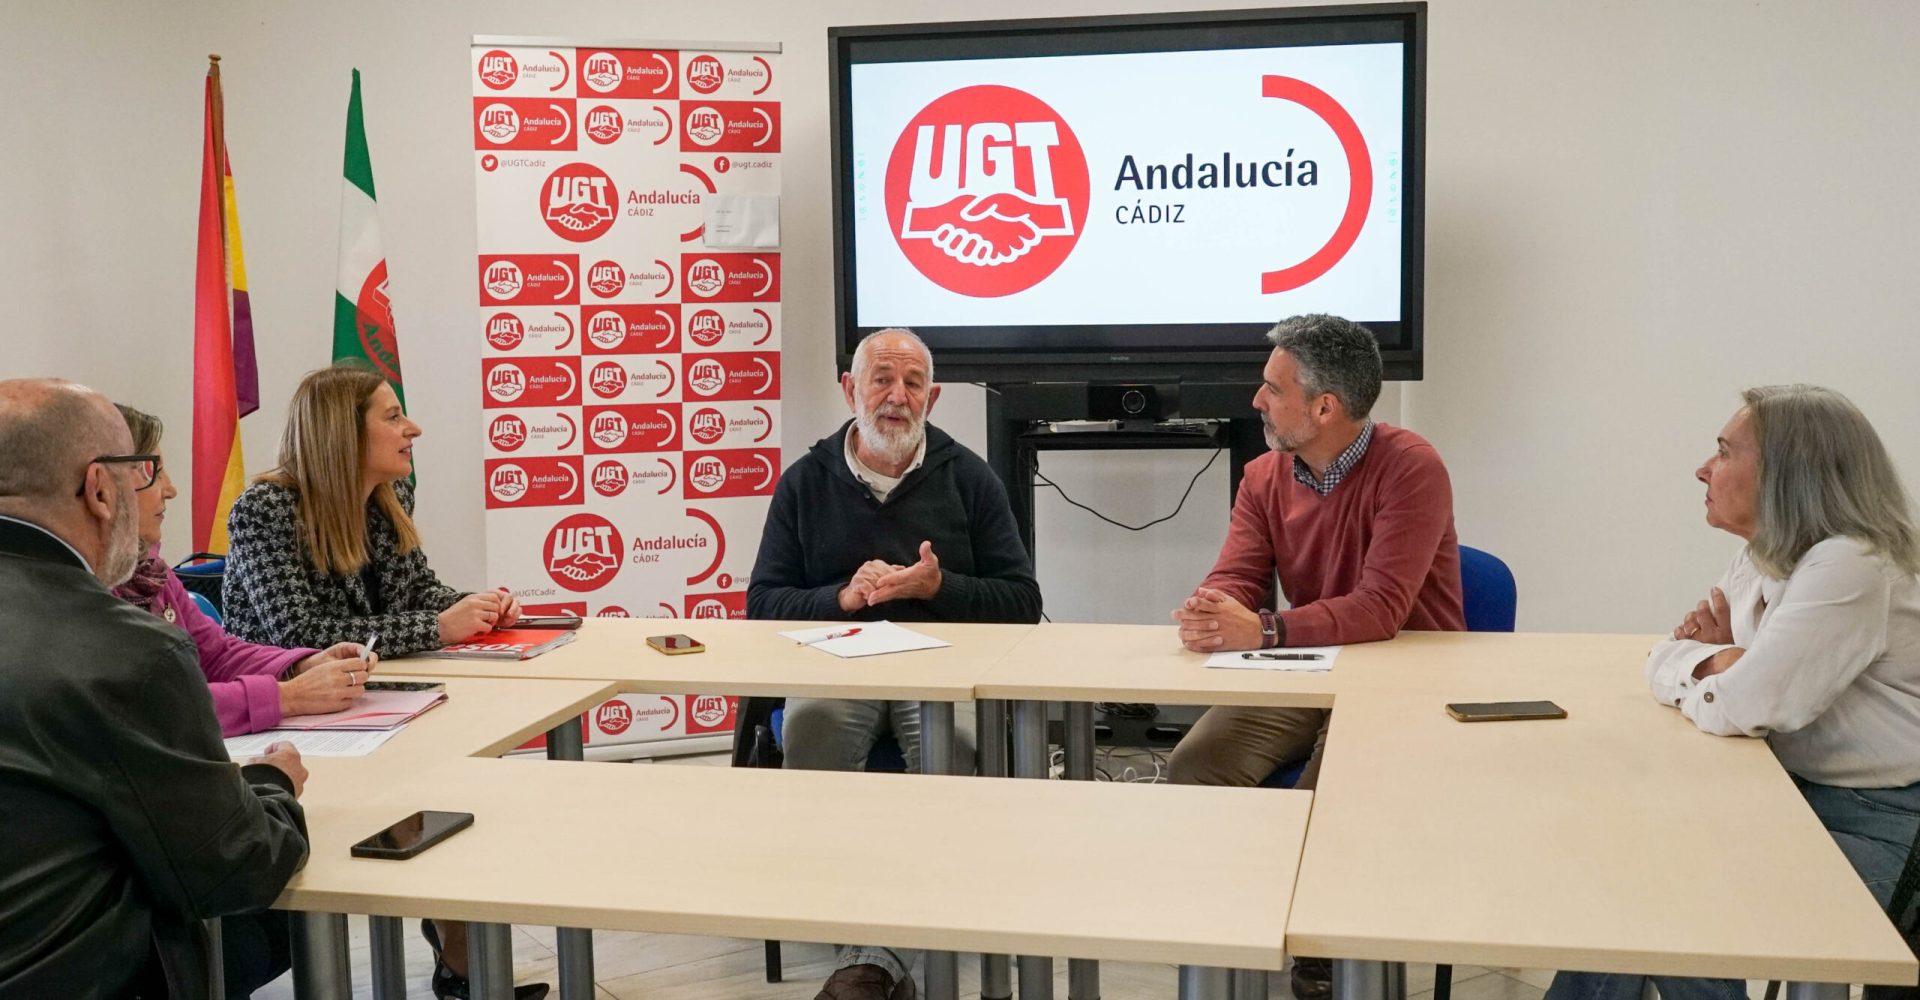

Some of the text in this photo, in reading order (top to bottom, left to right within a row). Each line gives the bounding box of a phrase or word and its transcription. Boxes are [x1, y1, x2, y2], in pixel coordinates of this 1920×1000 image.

[483, 57, 514, 73] UGT
[523, 64, 560, 73] Andalucía
[589, 59, 617, 75] UGT
[627, 67, 663, 75] Andalucía
[692, 61, 718, 76] UGT
[728, 68, 763, 76] Andalucía
[484, 111, 514, 126] UGT
[524, 118, 561, 126] Andalucía
[589, 112, 617, 126] UGT
[627, 119, 663, 127] Andalucía
[691, 114, 718, 128] UGT
[728, 120, 763, 129] Andalucía
[501, 158, 546, 168] @UGTCadiz
[732, 160, 772, 169] @ugt.cadiz
[910, 121, 1061, 205] UGT
[1114, 148, 1319, 191] Andalucía
[550, 177, 609, 206] UGT
[628, 189, 700, 205] Andalucía
[628, 207, 654, 216] CÁDIZ
[1116, 204, 1185, 225] CÁDIZ
[489, 268, 517, 283] UGT
[527, 273, 564, 281] Andalucía
[592, 267, 620, 282] UGT
[629, 272, 665, 280] Andalucía
[692, 266, 719, 280] UGT
[729, 271, 763, 279] Andalucía
[491, 319, 520, 334] UGT
[529, 324, 565, 332] Andalucía
[592, 318, 620, 332] UGT
[630, 322, 666, 331] Andalucía
[693, 316, 719, 330] UGT
[729, 321, 763, 329] Andalucía
[492, 370, 521, 385] UGT
[530, 375, 567, 383] Andalucía
[593, 368, 622, 382] UGT
[631, 372, 666, 381] Andalucía
[693, 365, 719, 379] UGT
[729, 370, 763, 378] Andalucía
[494, 421, 522, 436] UGT
[531, 425, 568, 433] Andalucía
[595, 417, 623, 432] UGT
[632, 421, 667, 430] Andalucía
[694, 415, 720, 429] UGT
[729, 418, 763, 426] Andalucía
[597, 467, 624, 481] UGT
[633, 470, 667, 479] Andalucía
[695, 463, 720, 477] UGT
[730, 466, 764, 474] Andalucía
[496, 471, 523, 485] UGT
[532, 474, 569, 483] Andalucía
[554, 527, 612, 559] UGT
[633, 533, 707, 551] Andalucía
[633, 553, 659, 563] CÁDIZ
[696, 604, 724, 619] UGT
[696, 698, 724, 712] UGT
[600, 706, 628, 720] UGT
